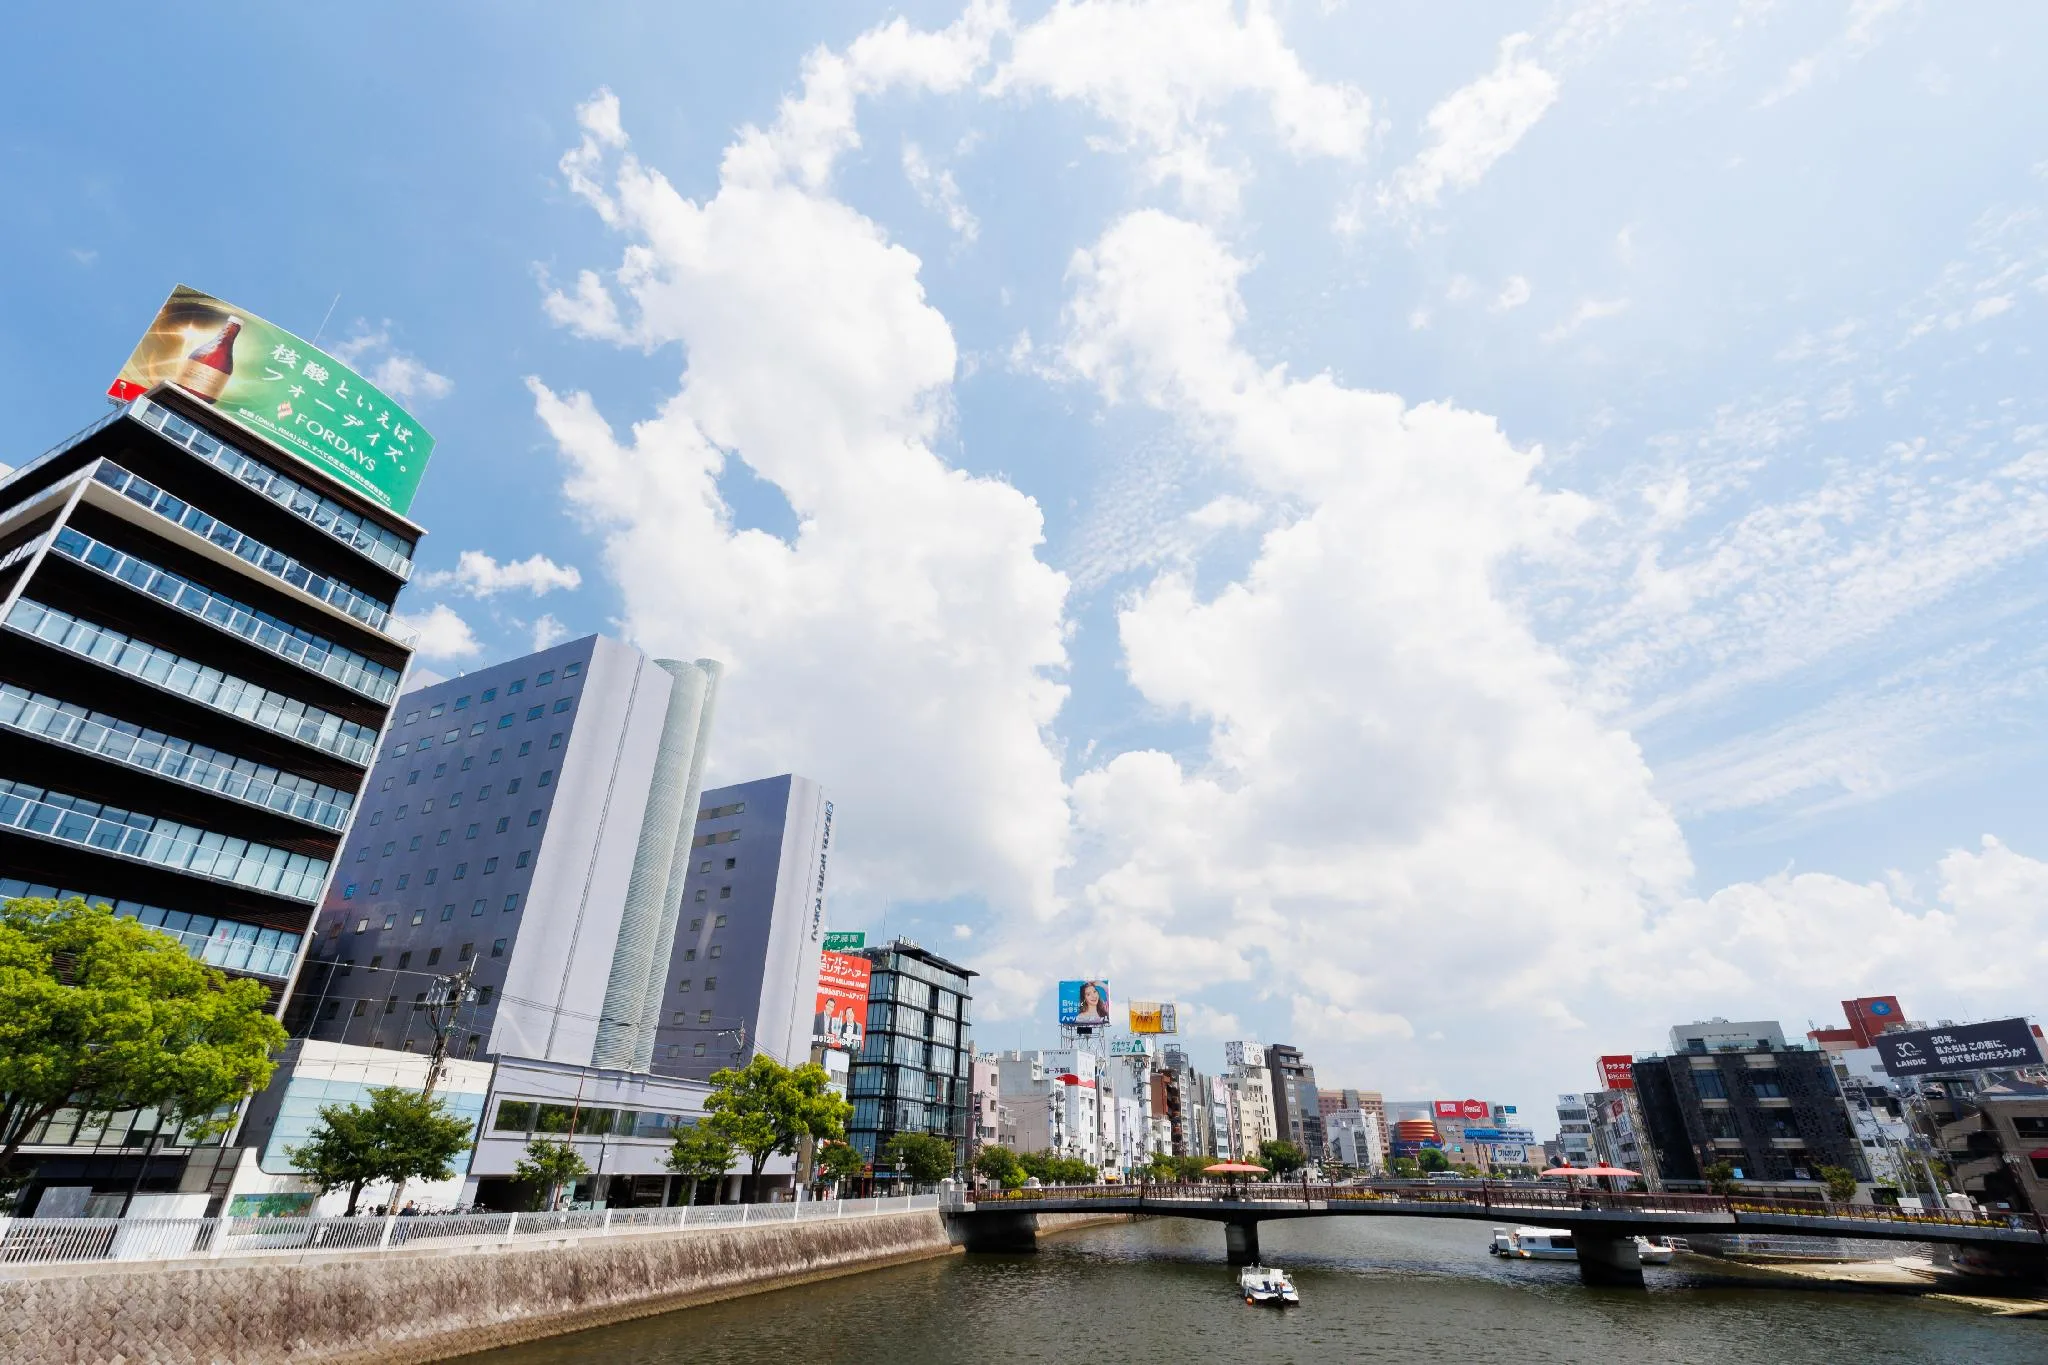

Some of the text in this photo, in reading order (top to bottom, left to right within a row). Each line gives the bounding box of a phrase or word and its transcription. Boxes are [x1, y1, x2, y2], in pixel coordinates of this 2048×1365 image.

[295, 412, 376, 472] FORDAYS
[817, 853, 827, 893] HOTEL
[811, 897, 822, 943] TOKYU
[820, 962, 868, 978] ミリオンヘアー
[1895, 1058, 1927, 1068] LANDIC
[1935, 1043, 1968, 1055] 私たちは
